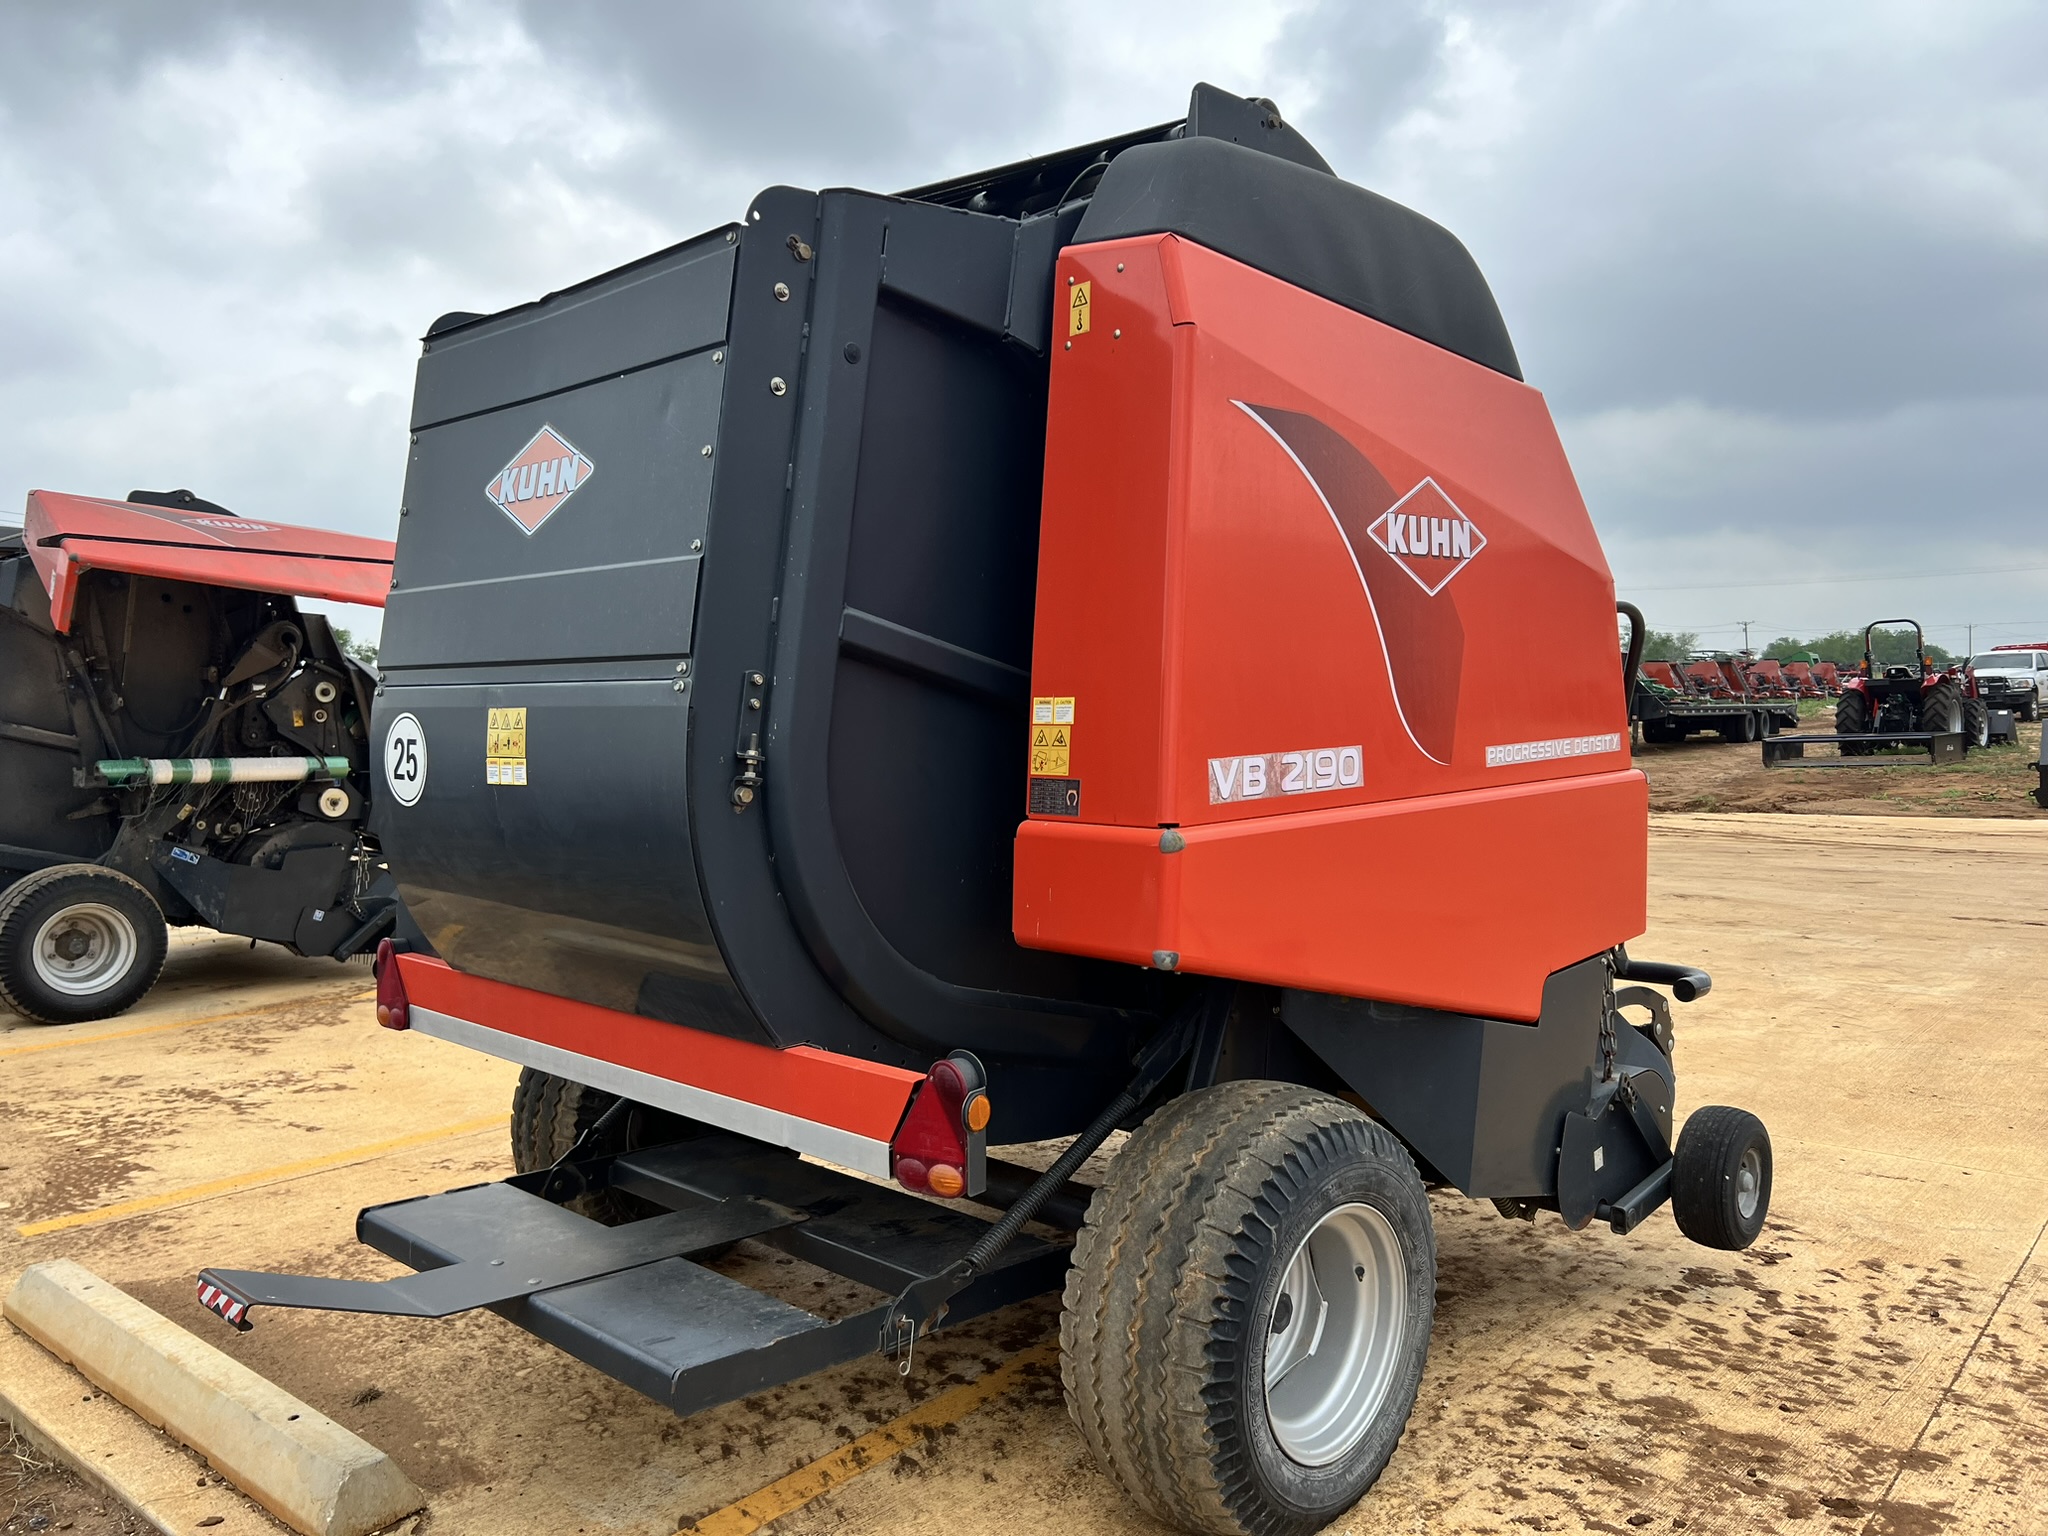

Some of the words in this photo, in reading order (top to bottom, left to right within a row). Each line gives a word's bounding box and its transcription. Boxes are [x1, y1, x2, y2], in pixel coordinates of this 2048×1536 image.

[498, 453, 581, 506] KUHN
[195, 518, 269, 531] KUHN
[1386, 512, 1471, 559] KUHN
[393, 737, 418, 782] 25
[1211, 756, 1267, 799] VB
[1280, 747, 1361, 791] 2190
[1487, 739, 1572, 765] PROGRESSIVE
